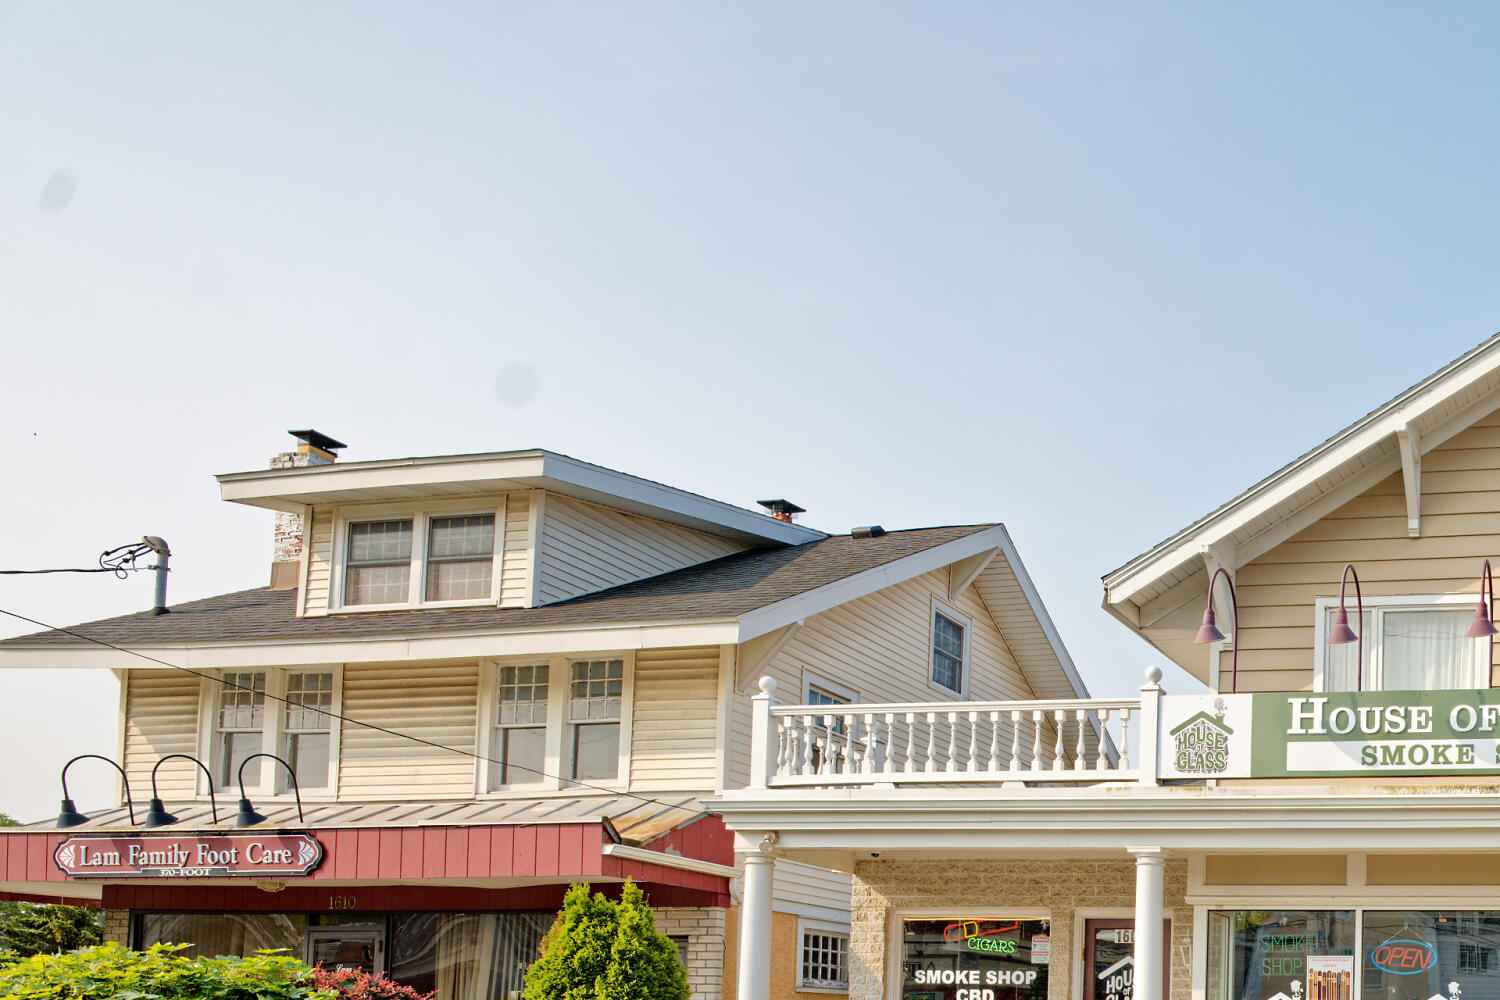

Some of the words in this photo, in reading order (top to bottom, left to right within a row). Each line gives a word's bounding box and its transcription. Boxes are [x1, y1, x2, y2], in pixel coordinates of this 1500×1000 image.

[1286, 697, 1433, 735] HOUSE
[1177, 724, 1224, 751] HOUSE
[1176, 751, 1226, 770] GLASS
[1361, 743, 1475, 767] SMOKE
[79, 845, 121, 867] Lam
[127, 843, 190, 869] Family
[196, 843, 239, 866] Foot
[246, 842, 293, 865] Care
[159, 867, 212, 877] 370-FOOT
[328, 895, 357, 910] 1610
[967, 937, 1016, 953] CIGARS
[1260, 934, 1316, 953] SMOKE
[1261, 957, 1303, 976] SHOP
[1375, 945, 1432, 969] OPEN
[914, 969, 980, 984] SMOKE
[986, 970, 1037, 985] SHOP
